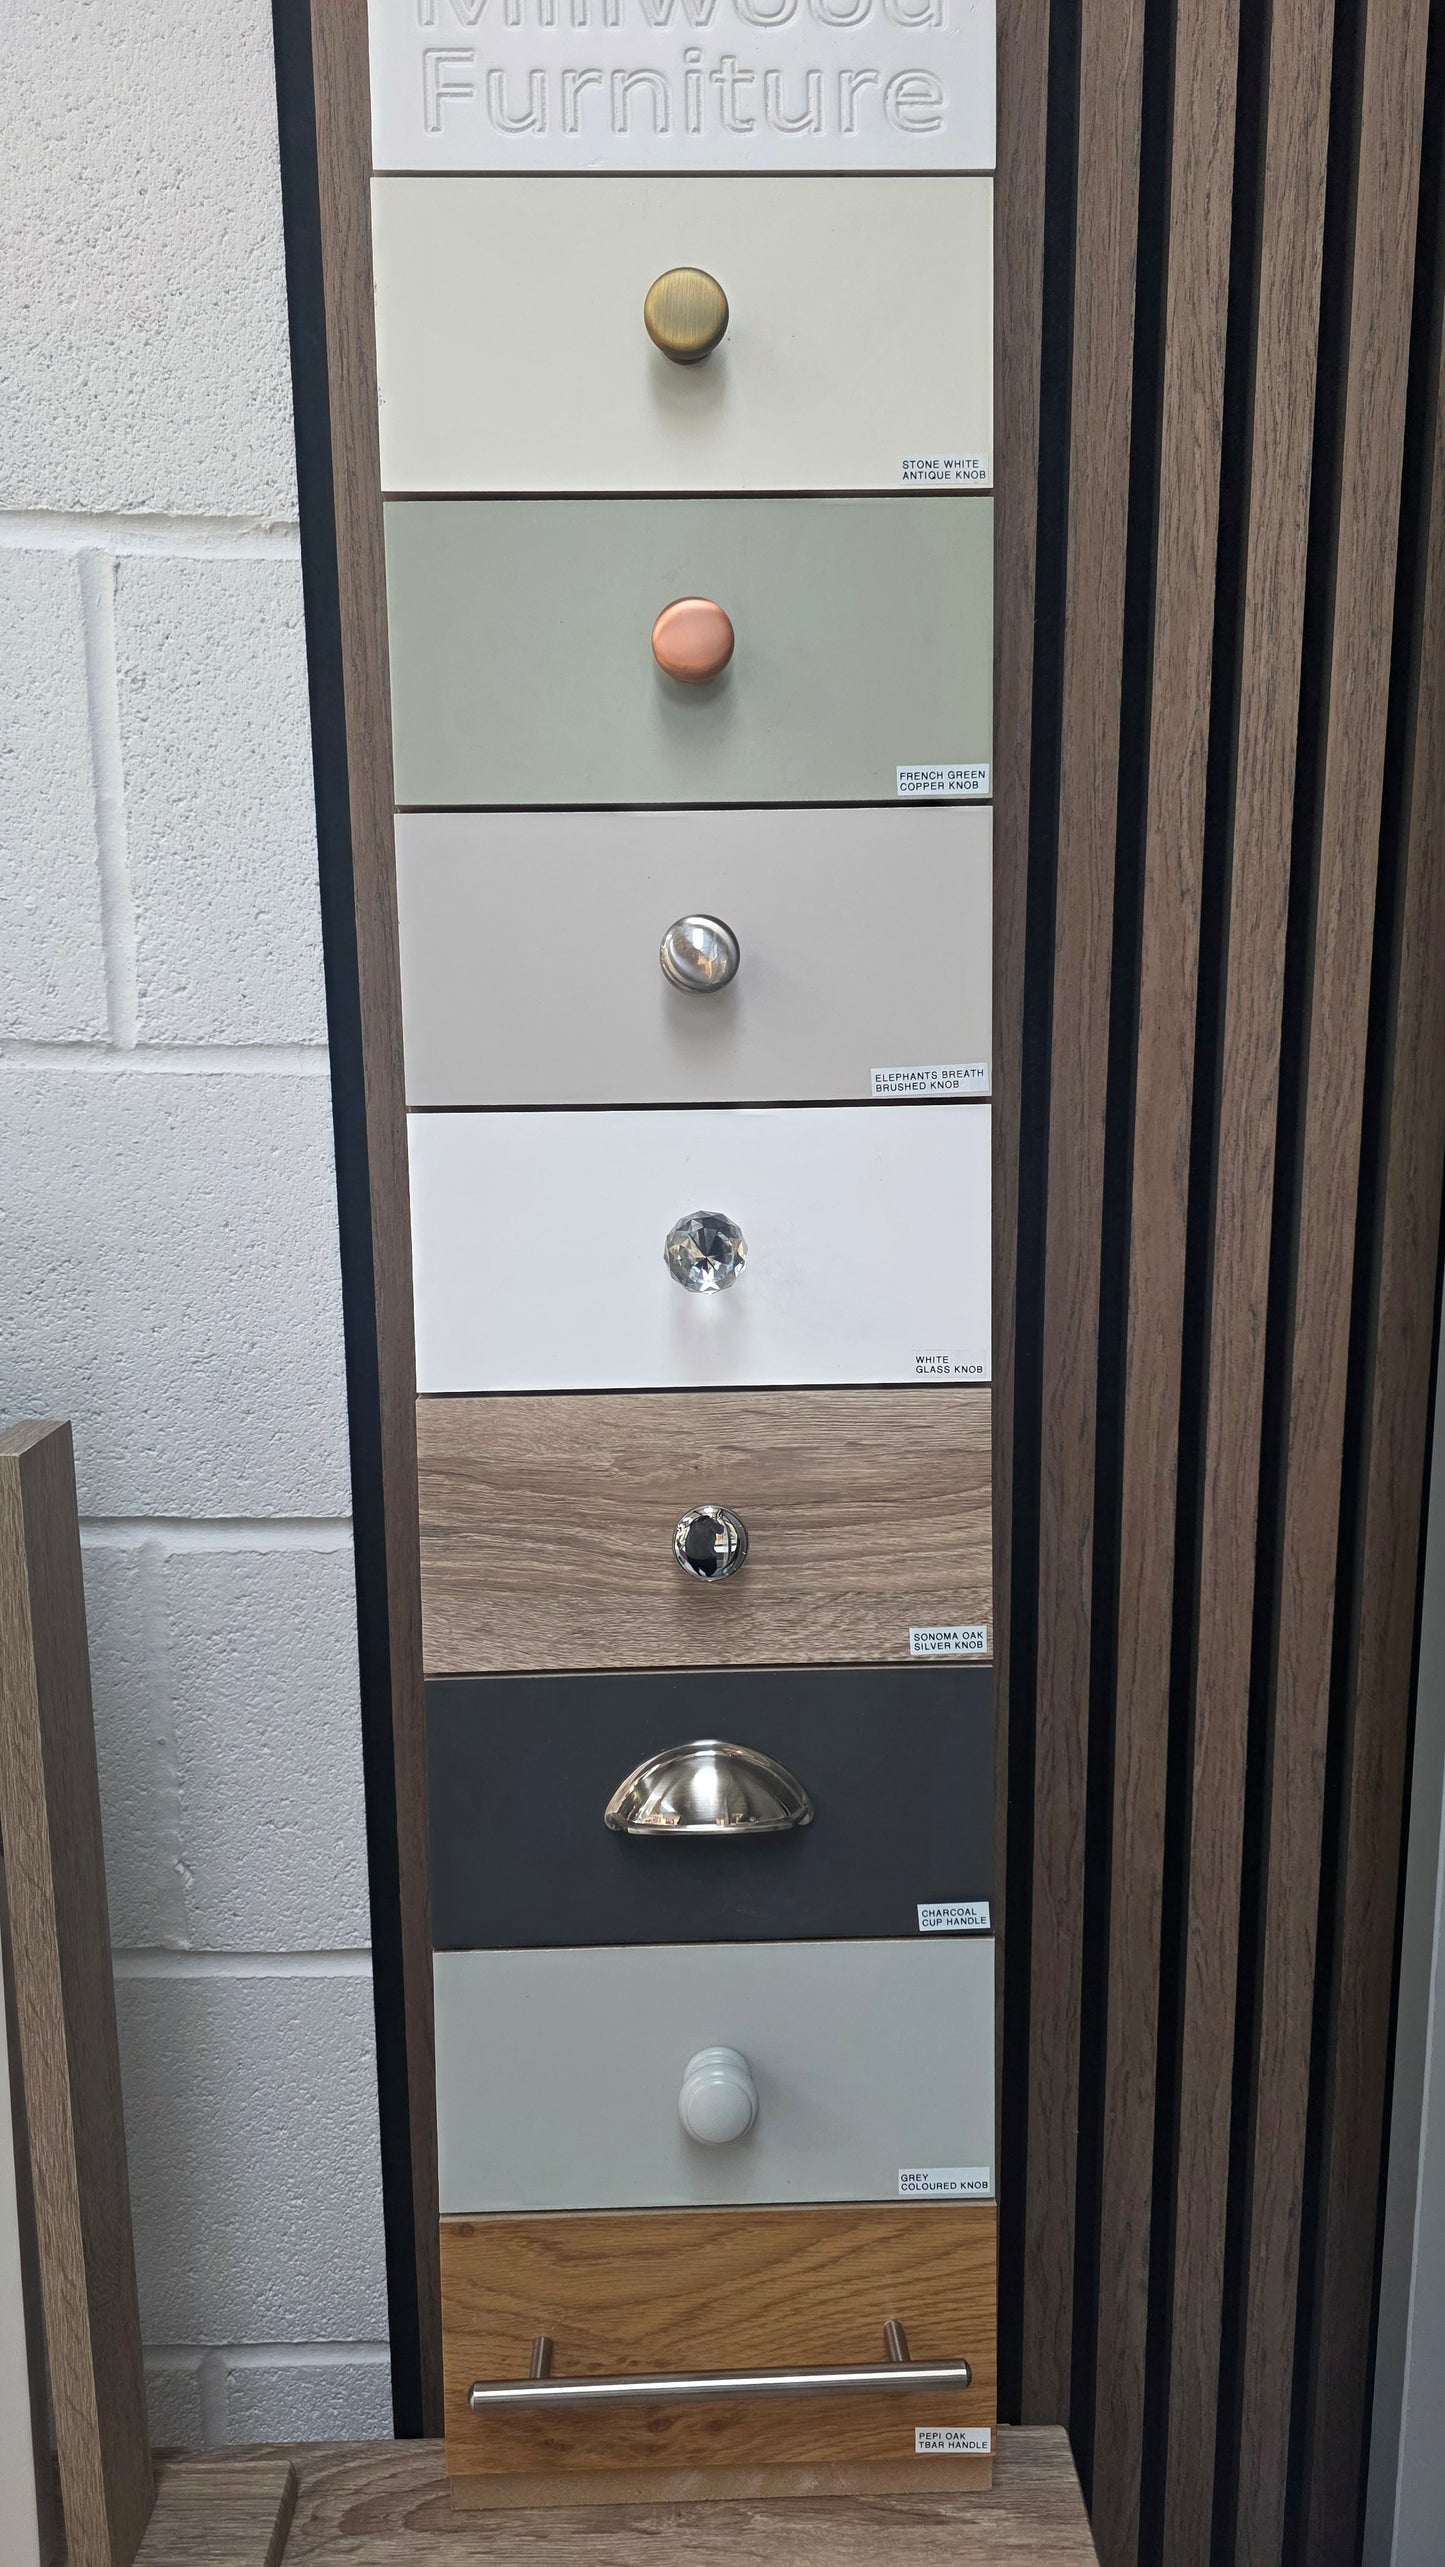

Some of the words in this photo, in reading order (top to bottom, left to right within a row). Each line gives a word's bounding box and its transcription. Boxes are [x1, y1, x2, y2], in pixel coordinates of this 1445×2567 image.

[421, 46, 948, 136] Furniture
[902, 460, 940, 469] STONE
[944, 460, 979, 468] WHITE
[902, 471, 951, 480] ANTIQUE
[956, 470, 986, 479] KNOB
[900, 772, 944, 780] FRENCH
[948, 770, 986, 780] GREEN
[900, 782, 944, 791] COPPER
[948, 781, 979, 790] KNOB
[876, 1071, 938, 1082] ELEPHANTS
[942, 1069, 984, 1078] BREATH
[876, 1082, 926, 1092] BRUSHED
[930, 1080, 960, 1089] KNOB
[916, 1366, 950, 1374] GLASS
[954, 1366, 983, 1374] KNOB
[914, 1632, 958, 1642] SONOMA
[962, 1632, 984, 1640] OAK
[914, 1642, 951, 1651] SILVER
[954, 1641, 984, 1650] KNOB
[922, 1908, 978, 1918] CHARCOAL
[922, 1919, 942, 1927] CUP
[946, 1916, 987, 1926] HANDLE
[900, 2174, 928, 2182] GREY
[900, 2182, 957, 2191] COLOURED
[960, 2182, 988, 2190] KNOB
